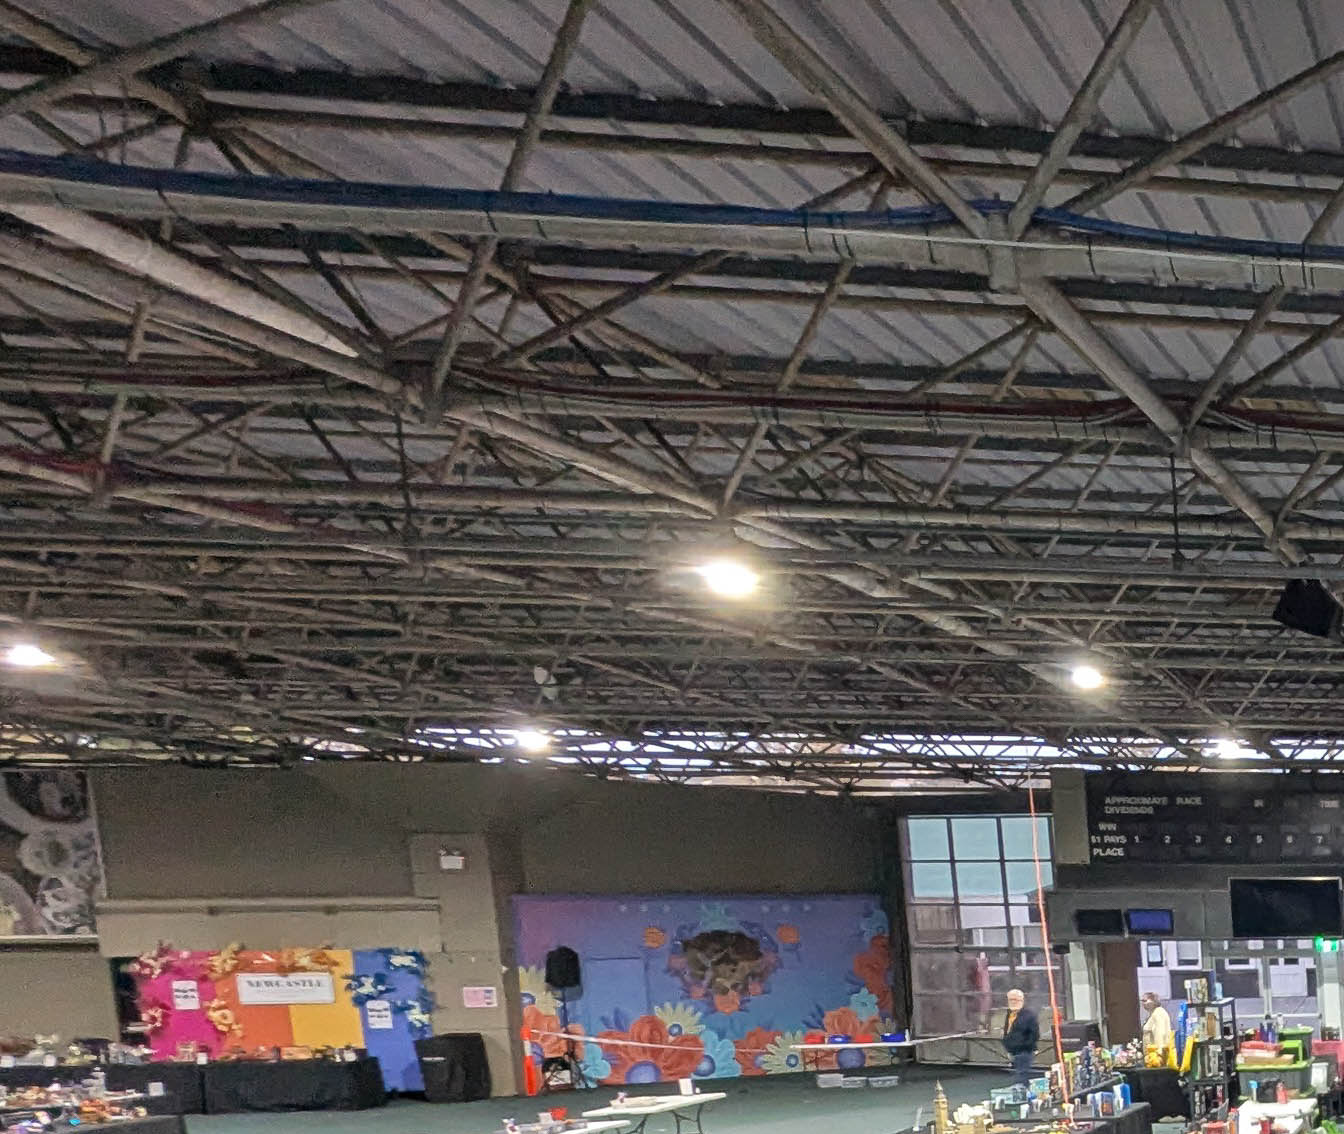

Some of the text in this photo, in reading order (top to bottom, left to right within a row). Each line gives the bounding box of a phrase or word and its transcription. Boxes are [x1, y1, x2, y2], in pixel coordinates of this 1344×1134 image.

[1176, 796, 1203, 805] RACE
[1098, 823, 1117, 831] WIN
[1103, 835, 1128, 844] PAYS
[1092, 847, 1125, 857] PLACE
